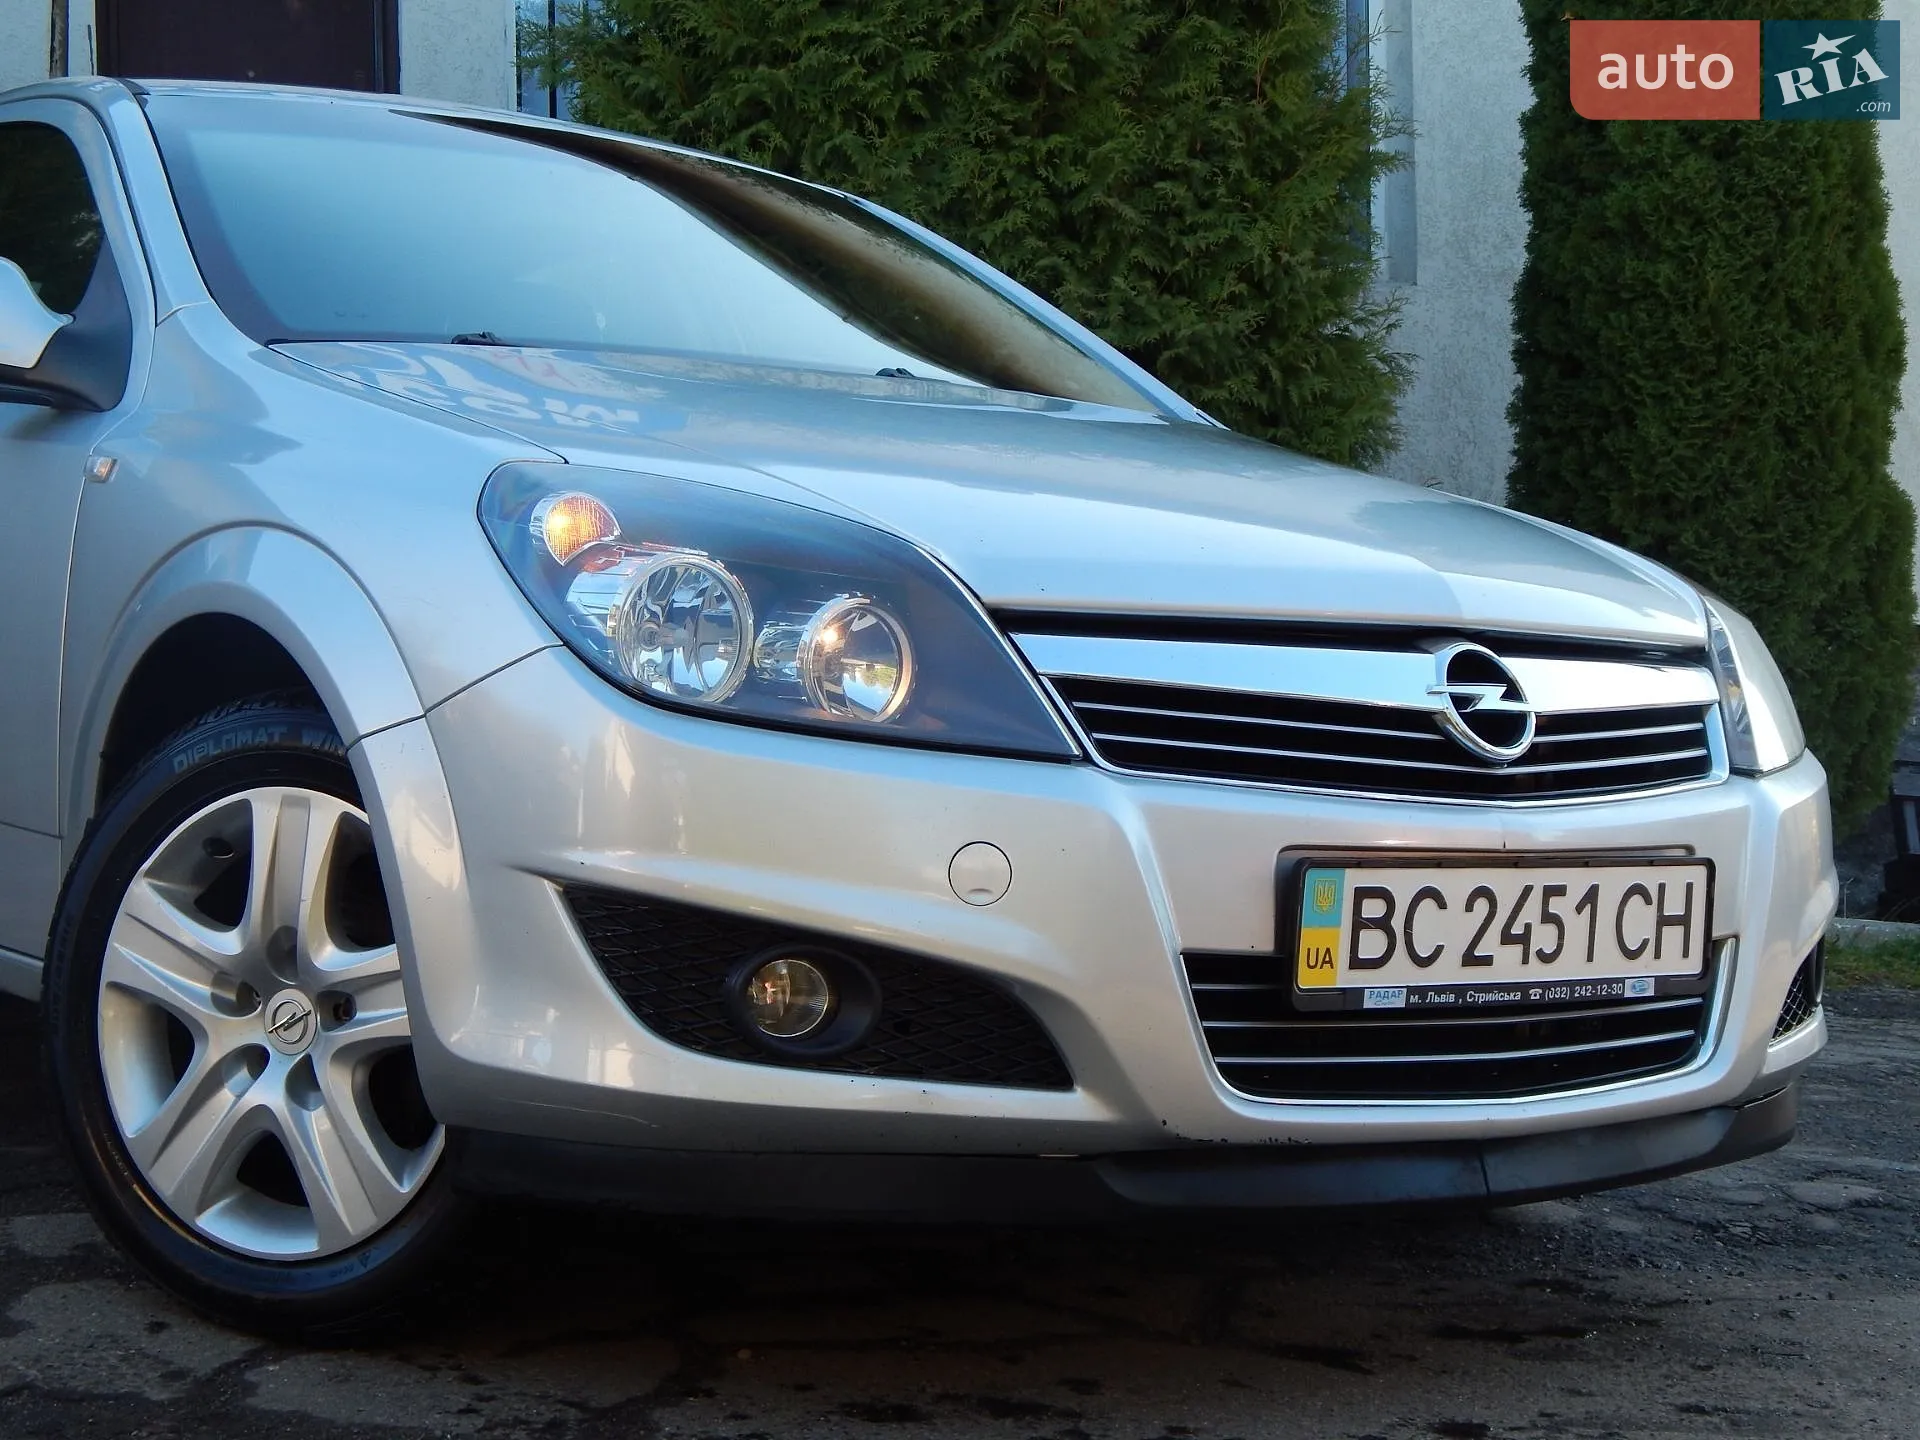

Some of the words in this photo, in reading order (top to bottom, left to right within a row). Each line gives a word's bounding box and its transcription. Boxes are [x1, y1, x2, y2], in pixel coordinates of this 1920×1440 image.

[172, 726, 288, 774] DIPLOMAT
[1349, 885, 1448, 970] BC
[1460, 883, 1600, 967] 2451
[1615, 881, 1694, 961] CH
[1306, 947, 1335, 970] UA
[1369, 989, 1404, 1000] РАДАР
[1466, 989, 1521, 1004] Стрийська
[1574, 983, 1623, 998] 242-12-30
